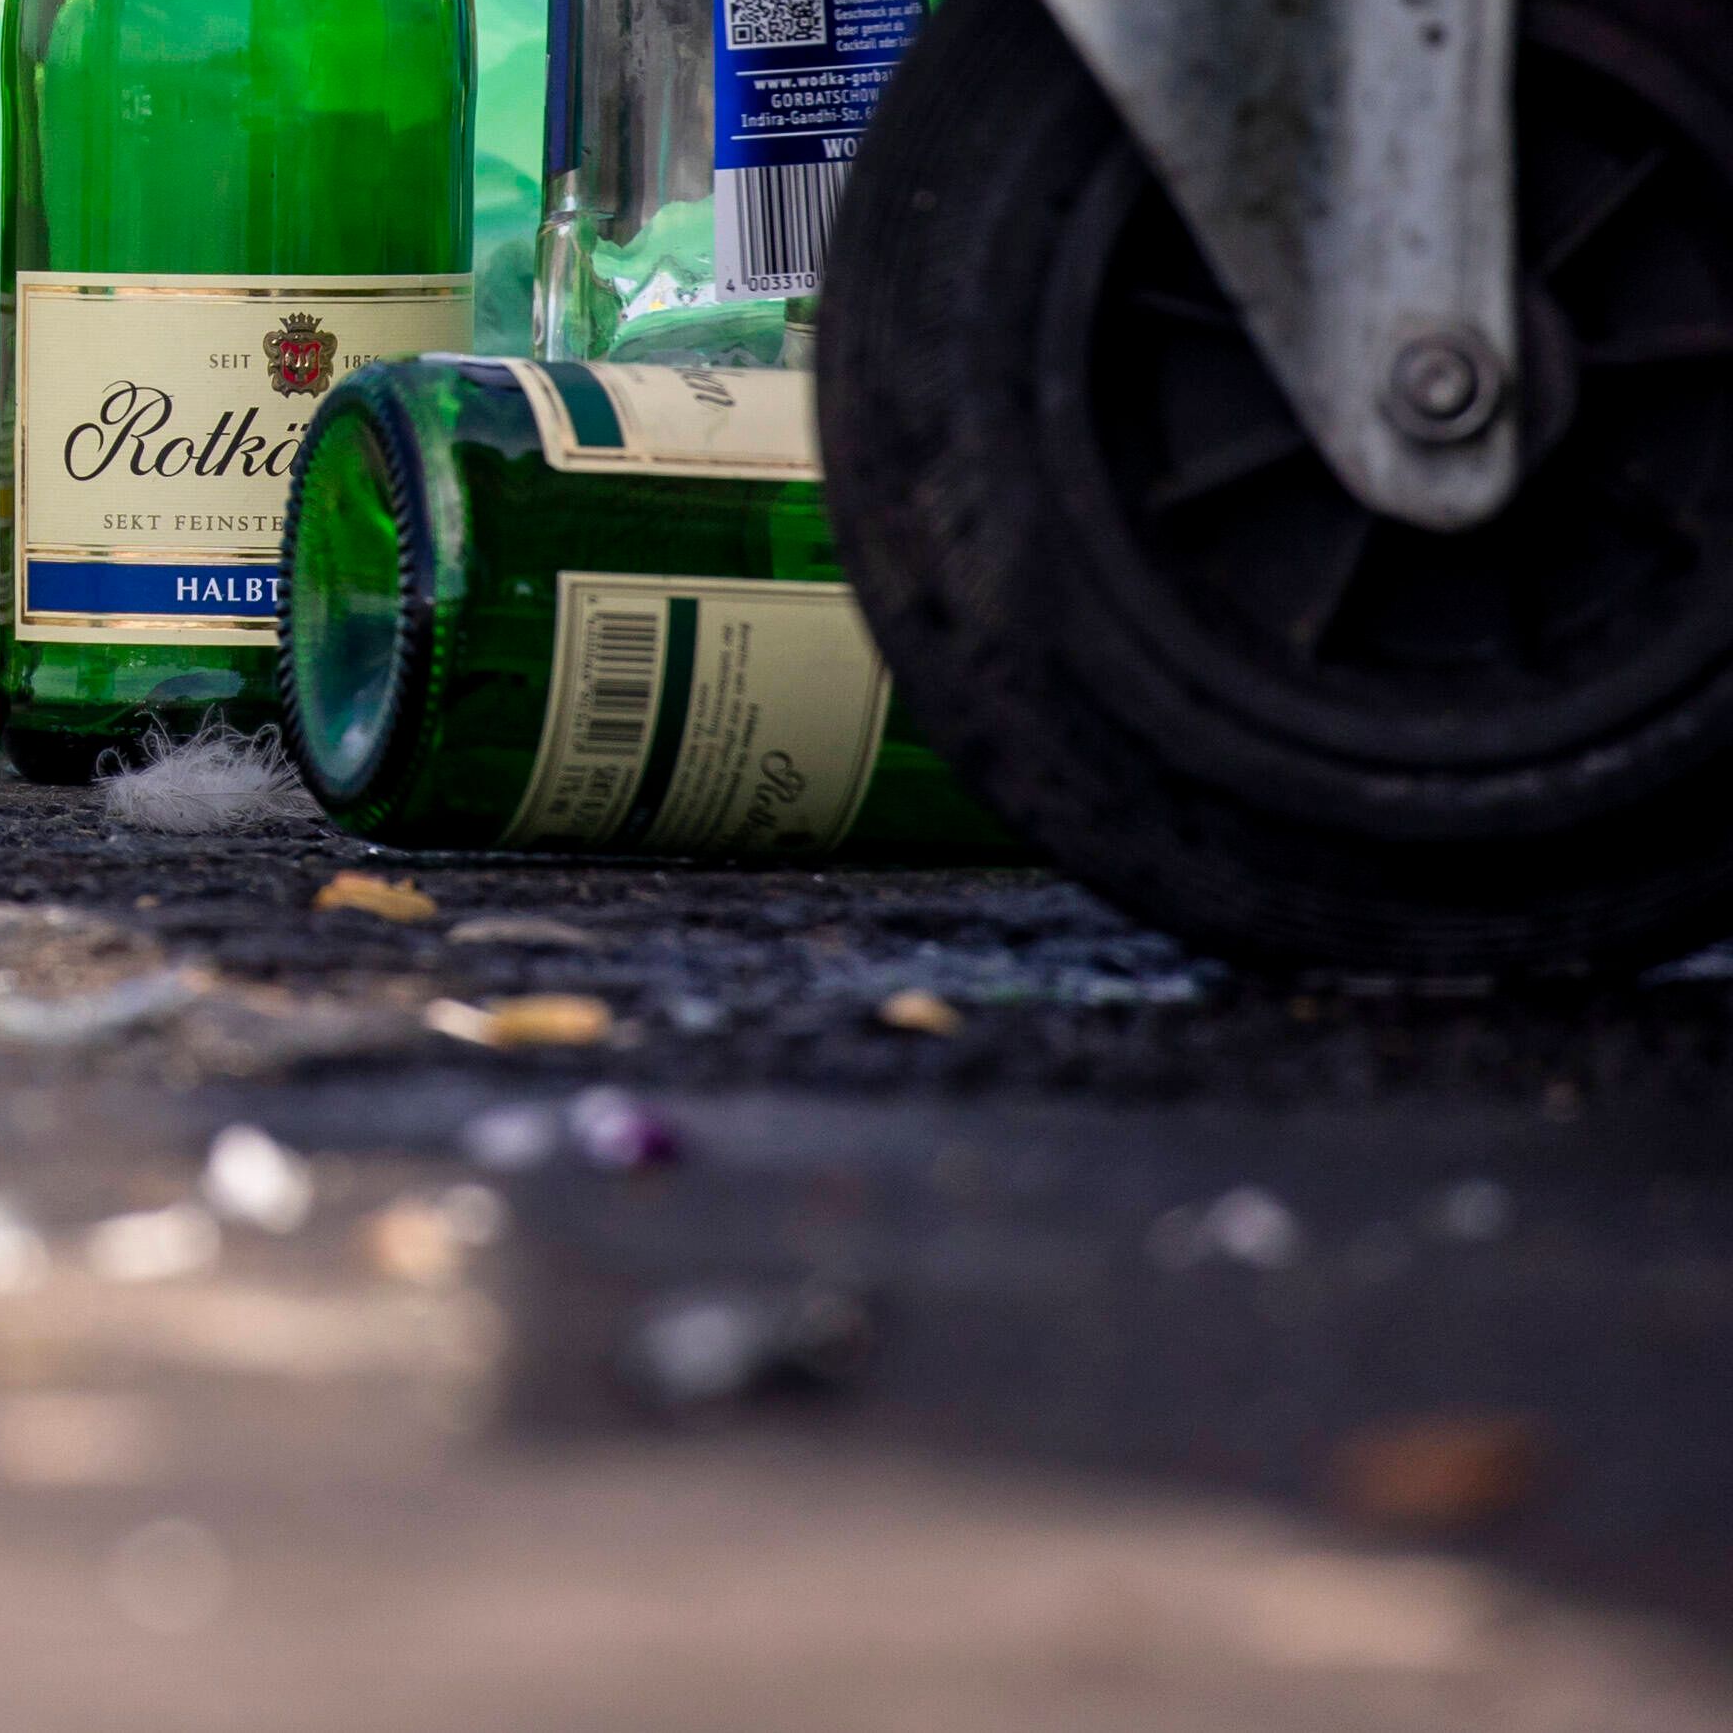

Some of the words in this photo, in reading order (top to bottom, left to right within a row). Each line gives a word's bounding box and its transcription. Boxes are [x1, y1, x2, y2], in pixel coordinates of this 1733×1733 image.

[771, 87, 880, 108] GORBATSCHOW
[822, 136, 863, 159] WO
[748, 273, 816, 292] 003310
[208, 353, 252, 369] SEIT
[103, 514, 162, 532] SEKT
[174, 514, 284, 533] FEINSTE
[176, 577, 282, 602] HALBT
